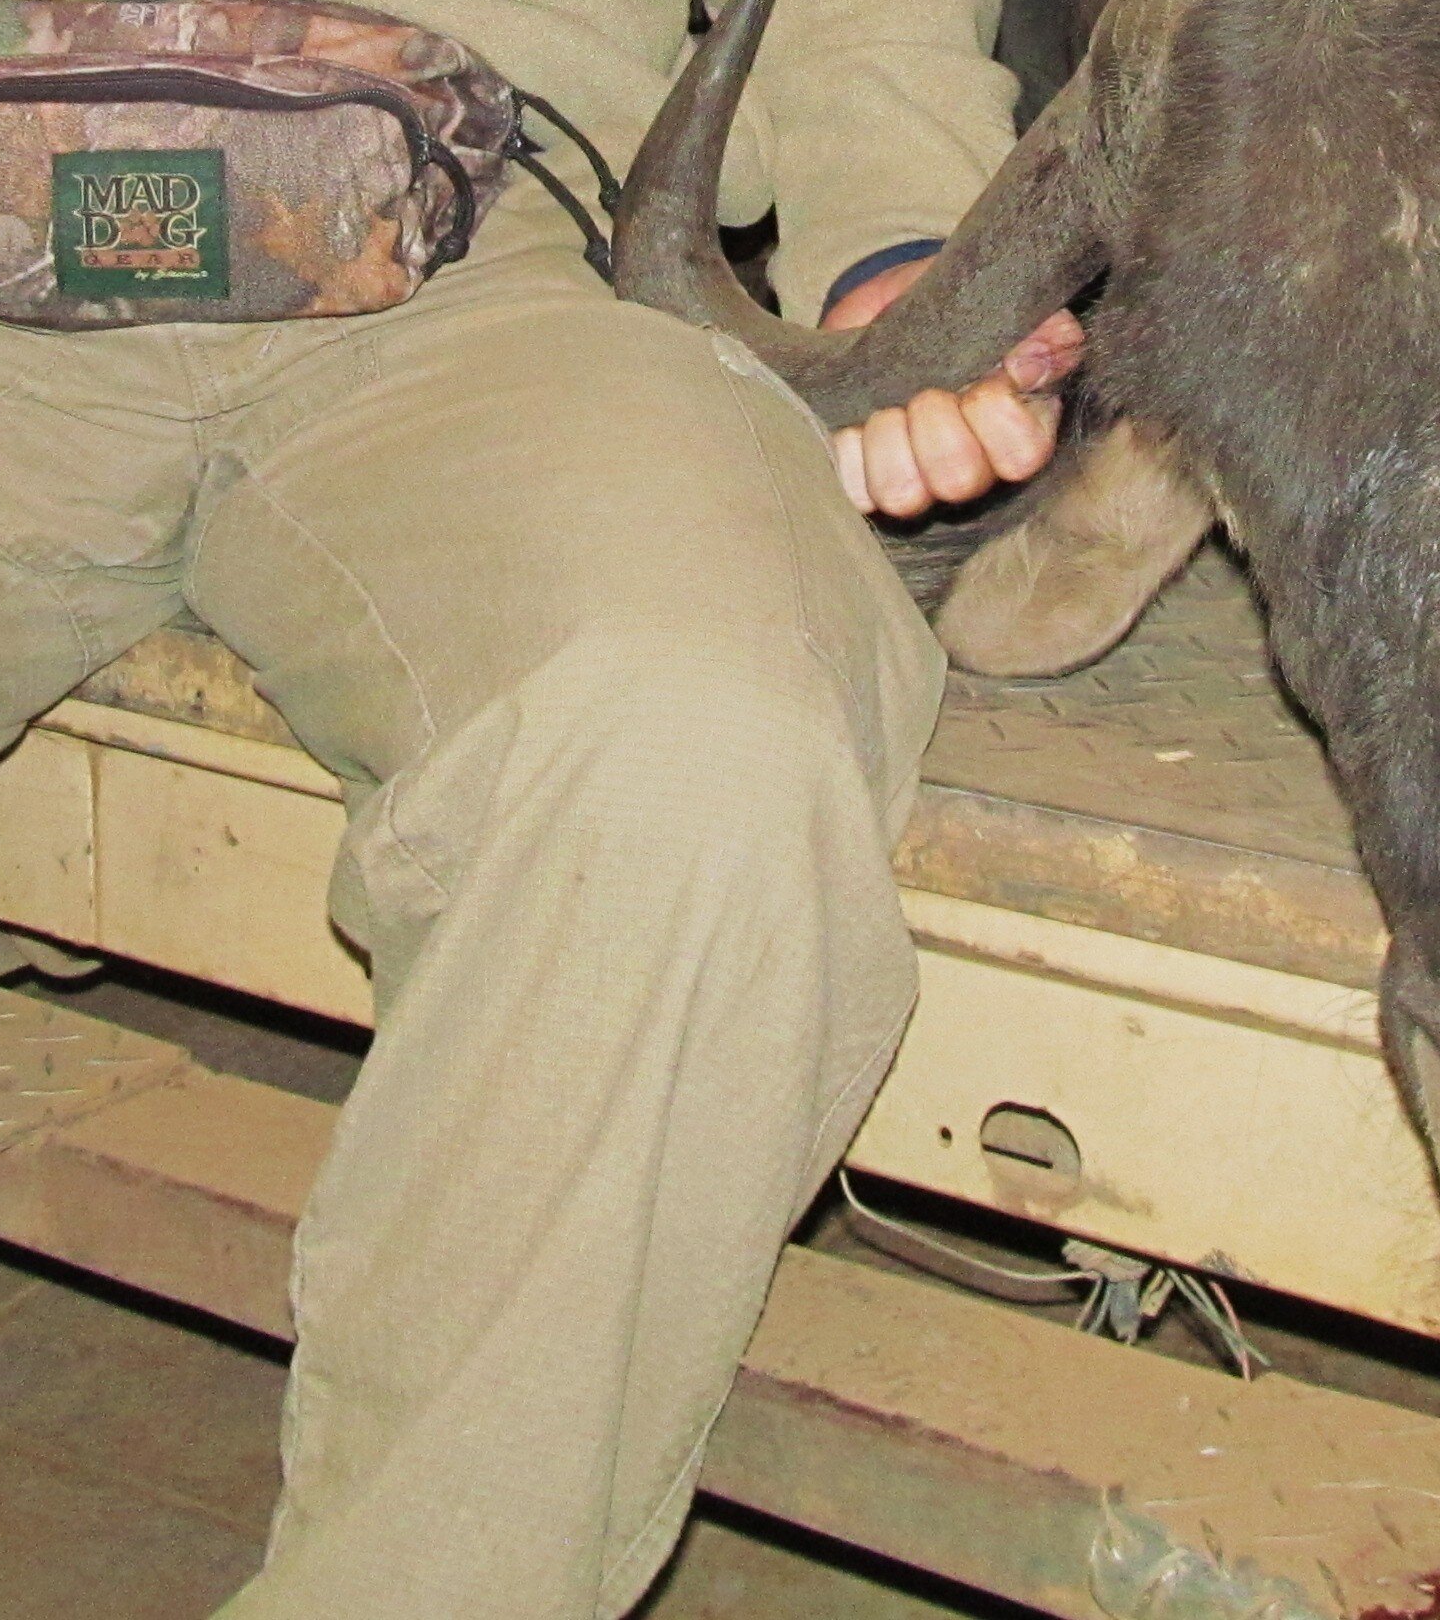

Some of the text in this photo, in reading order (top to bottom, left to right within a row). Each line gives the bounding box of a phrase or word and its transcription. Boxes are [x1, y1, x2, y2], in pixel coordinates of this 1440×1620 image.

[72, 173, 201, 218] MAD
[73, 209, 208, 251] DG
[84, 252, 196, 266] GEAR
